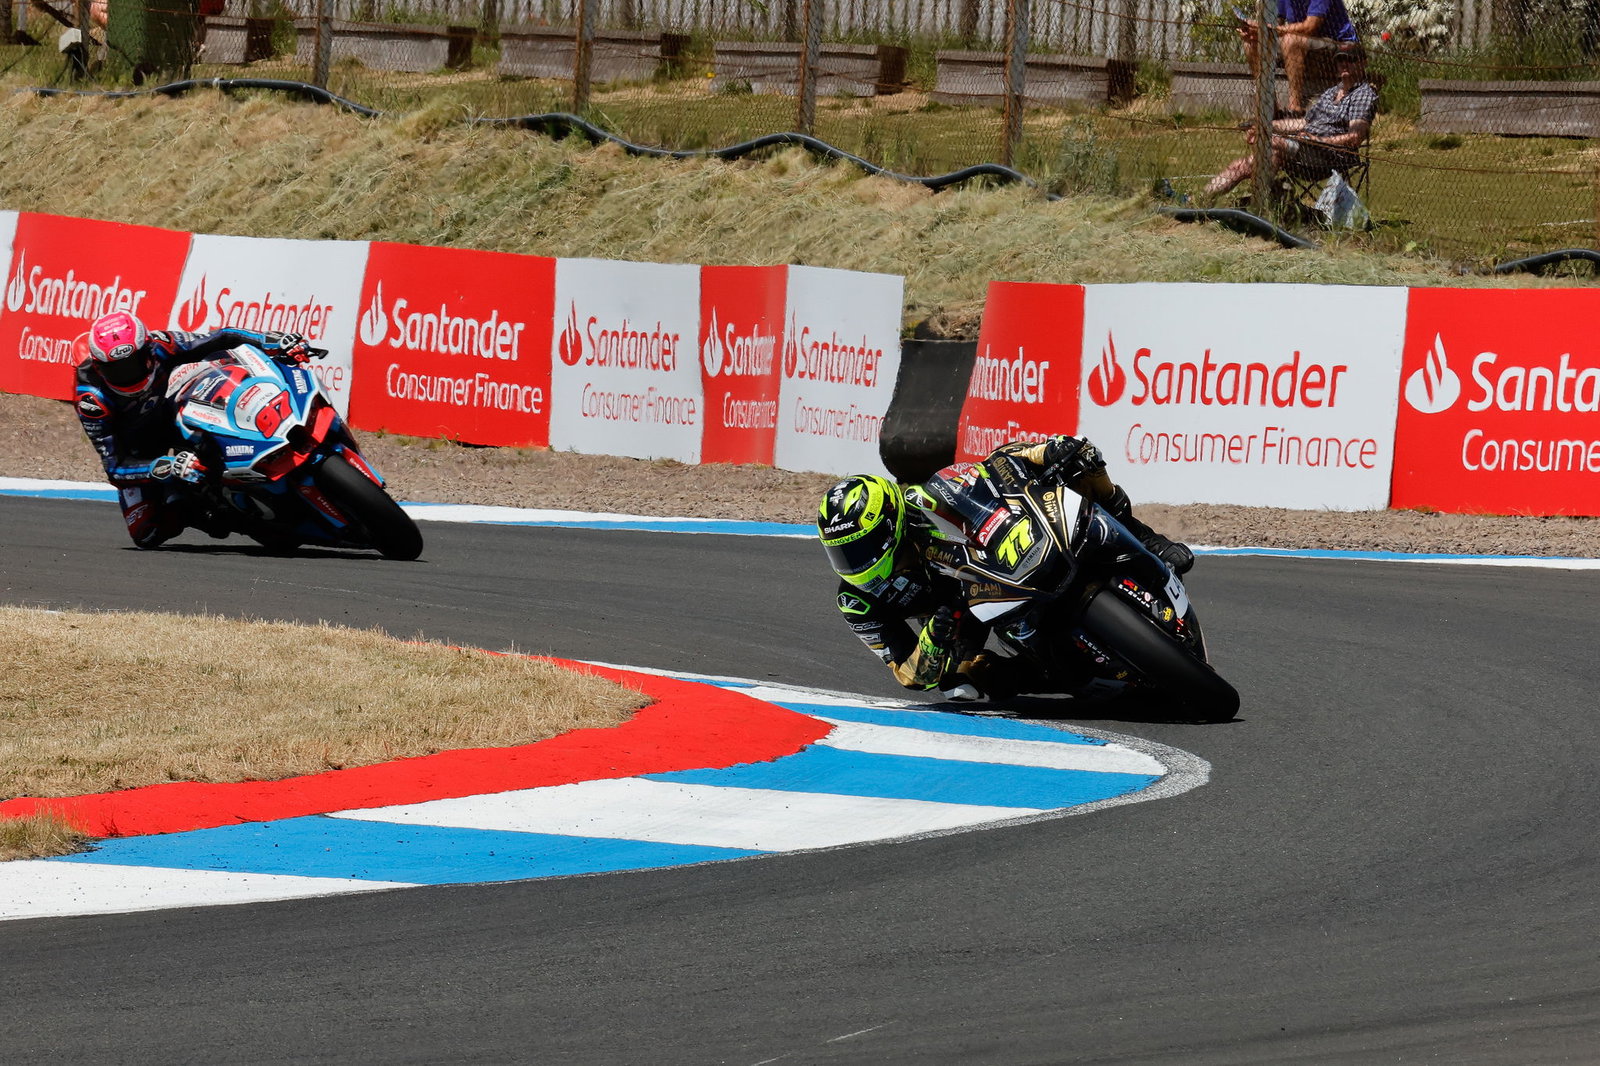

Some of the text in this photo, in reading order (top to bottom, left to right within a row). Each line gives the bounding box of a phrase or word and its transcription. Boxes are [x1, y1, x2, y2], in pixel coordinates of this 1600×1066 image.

[25, 265, 147, 320] Santander
[209, 288, 334, 340] Santander
[19, 326, 75, 366] Consum
[113, 345, 133, 357] Arai
[390, 298, 525, 361] Santander
[585, 316, 679, 371] Santander
[798, 326, 883, 388] Santander
[1131, 347, 1347, 408] Santander
[386, 363, 473, 406] Consumer
[473, 373, 543, 415] Finance
[581, 382, 696, 426] Consumer Finance
[1467, 351, 1600, 413] Santa
[794, 397, 849, 438] Consumer
[1125, 423, 1378, 469] Consumer Finance
[1462, 428, 1600, 473] Consume
[823, 521, 855, 534] SHARK
[1044, 501, 1057, 523] LAMI
[996, 516, 1034, 570] 77
[978, 582, 1001, 595] LAMI
